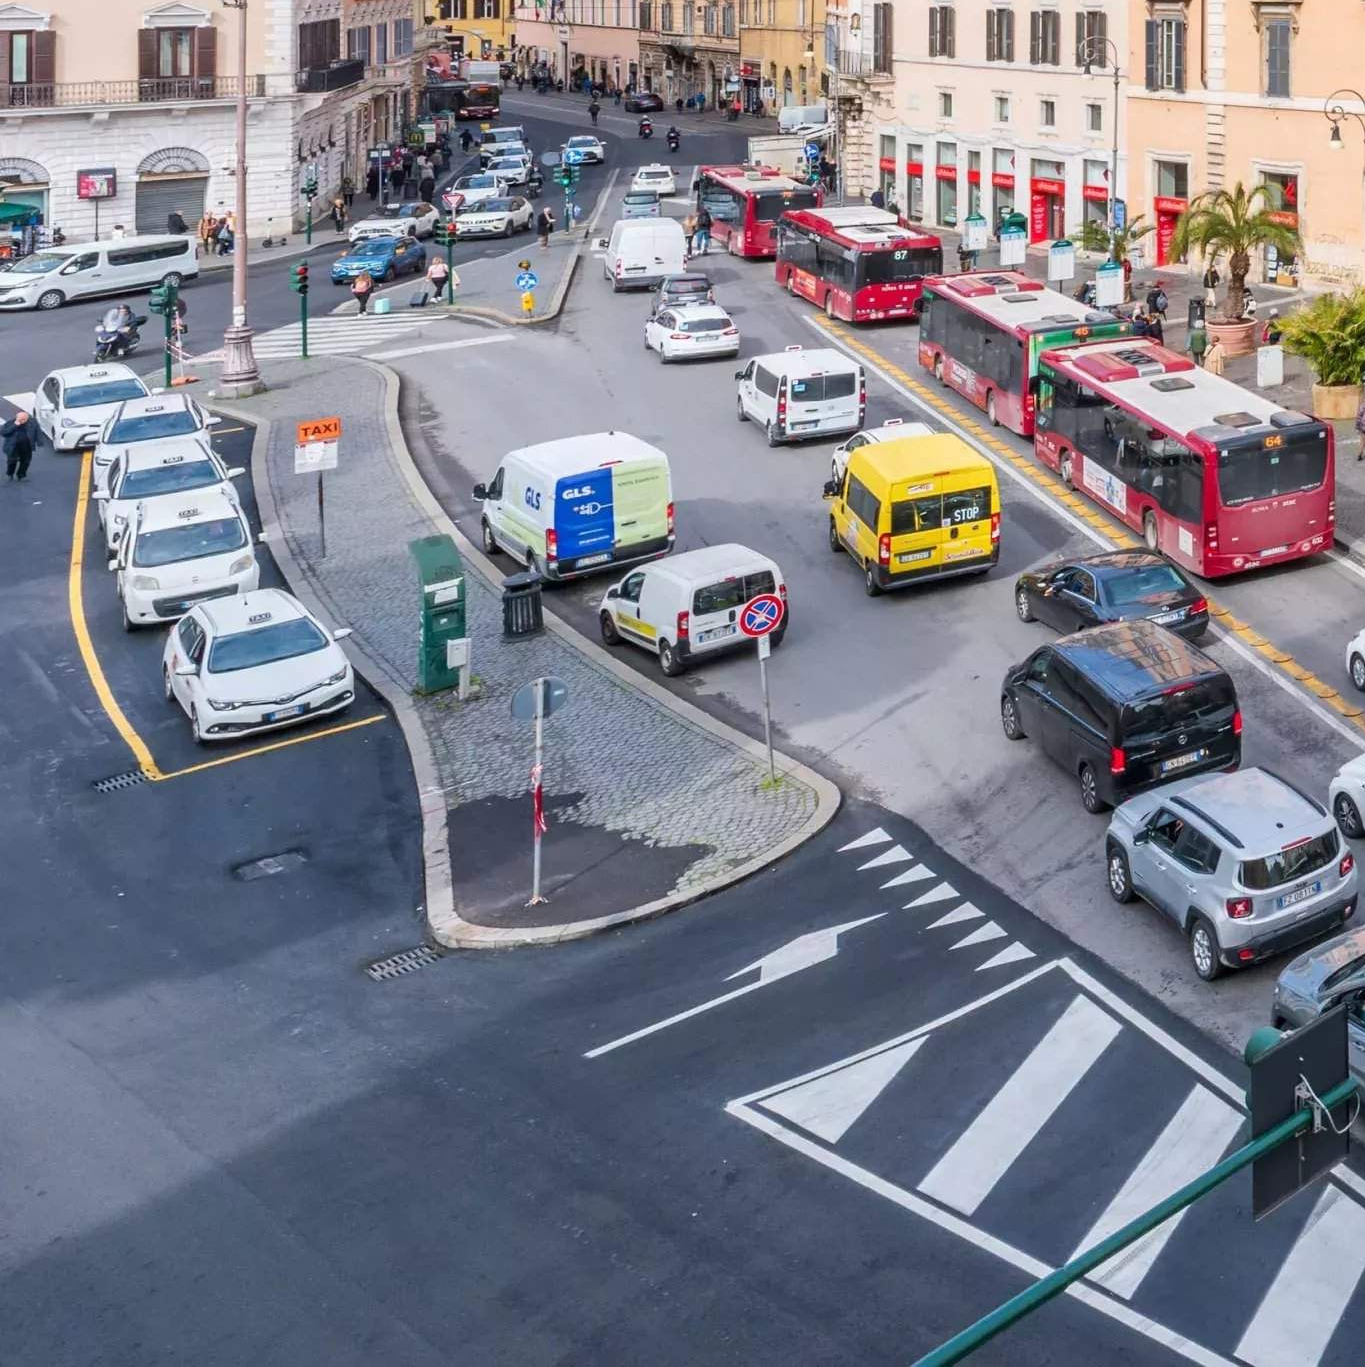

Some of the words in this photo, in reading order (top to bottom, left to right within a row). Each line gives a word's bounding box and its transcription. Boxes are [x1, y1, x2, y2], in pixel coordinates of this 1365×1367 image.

[894, 250, 908, 261] 87
[301, 422, 337, 437] TAXI
[1264, 436, 1282, 448] 64
[524, 486, 542, 511] GLS
[562, 485, 592, 500] GLS
[954, 506, 981, 522] STOP
